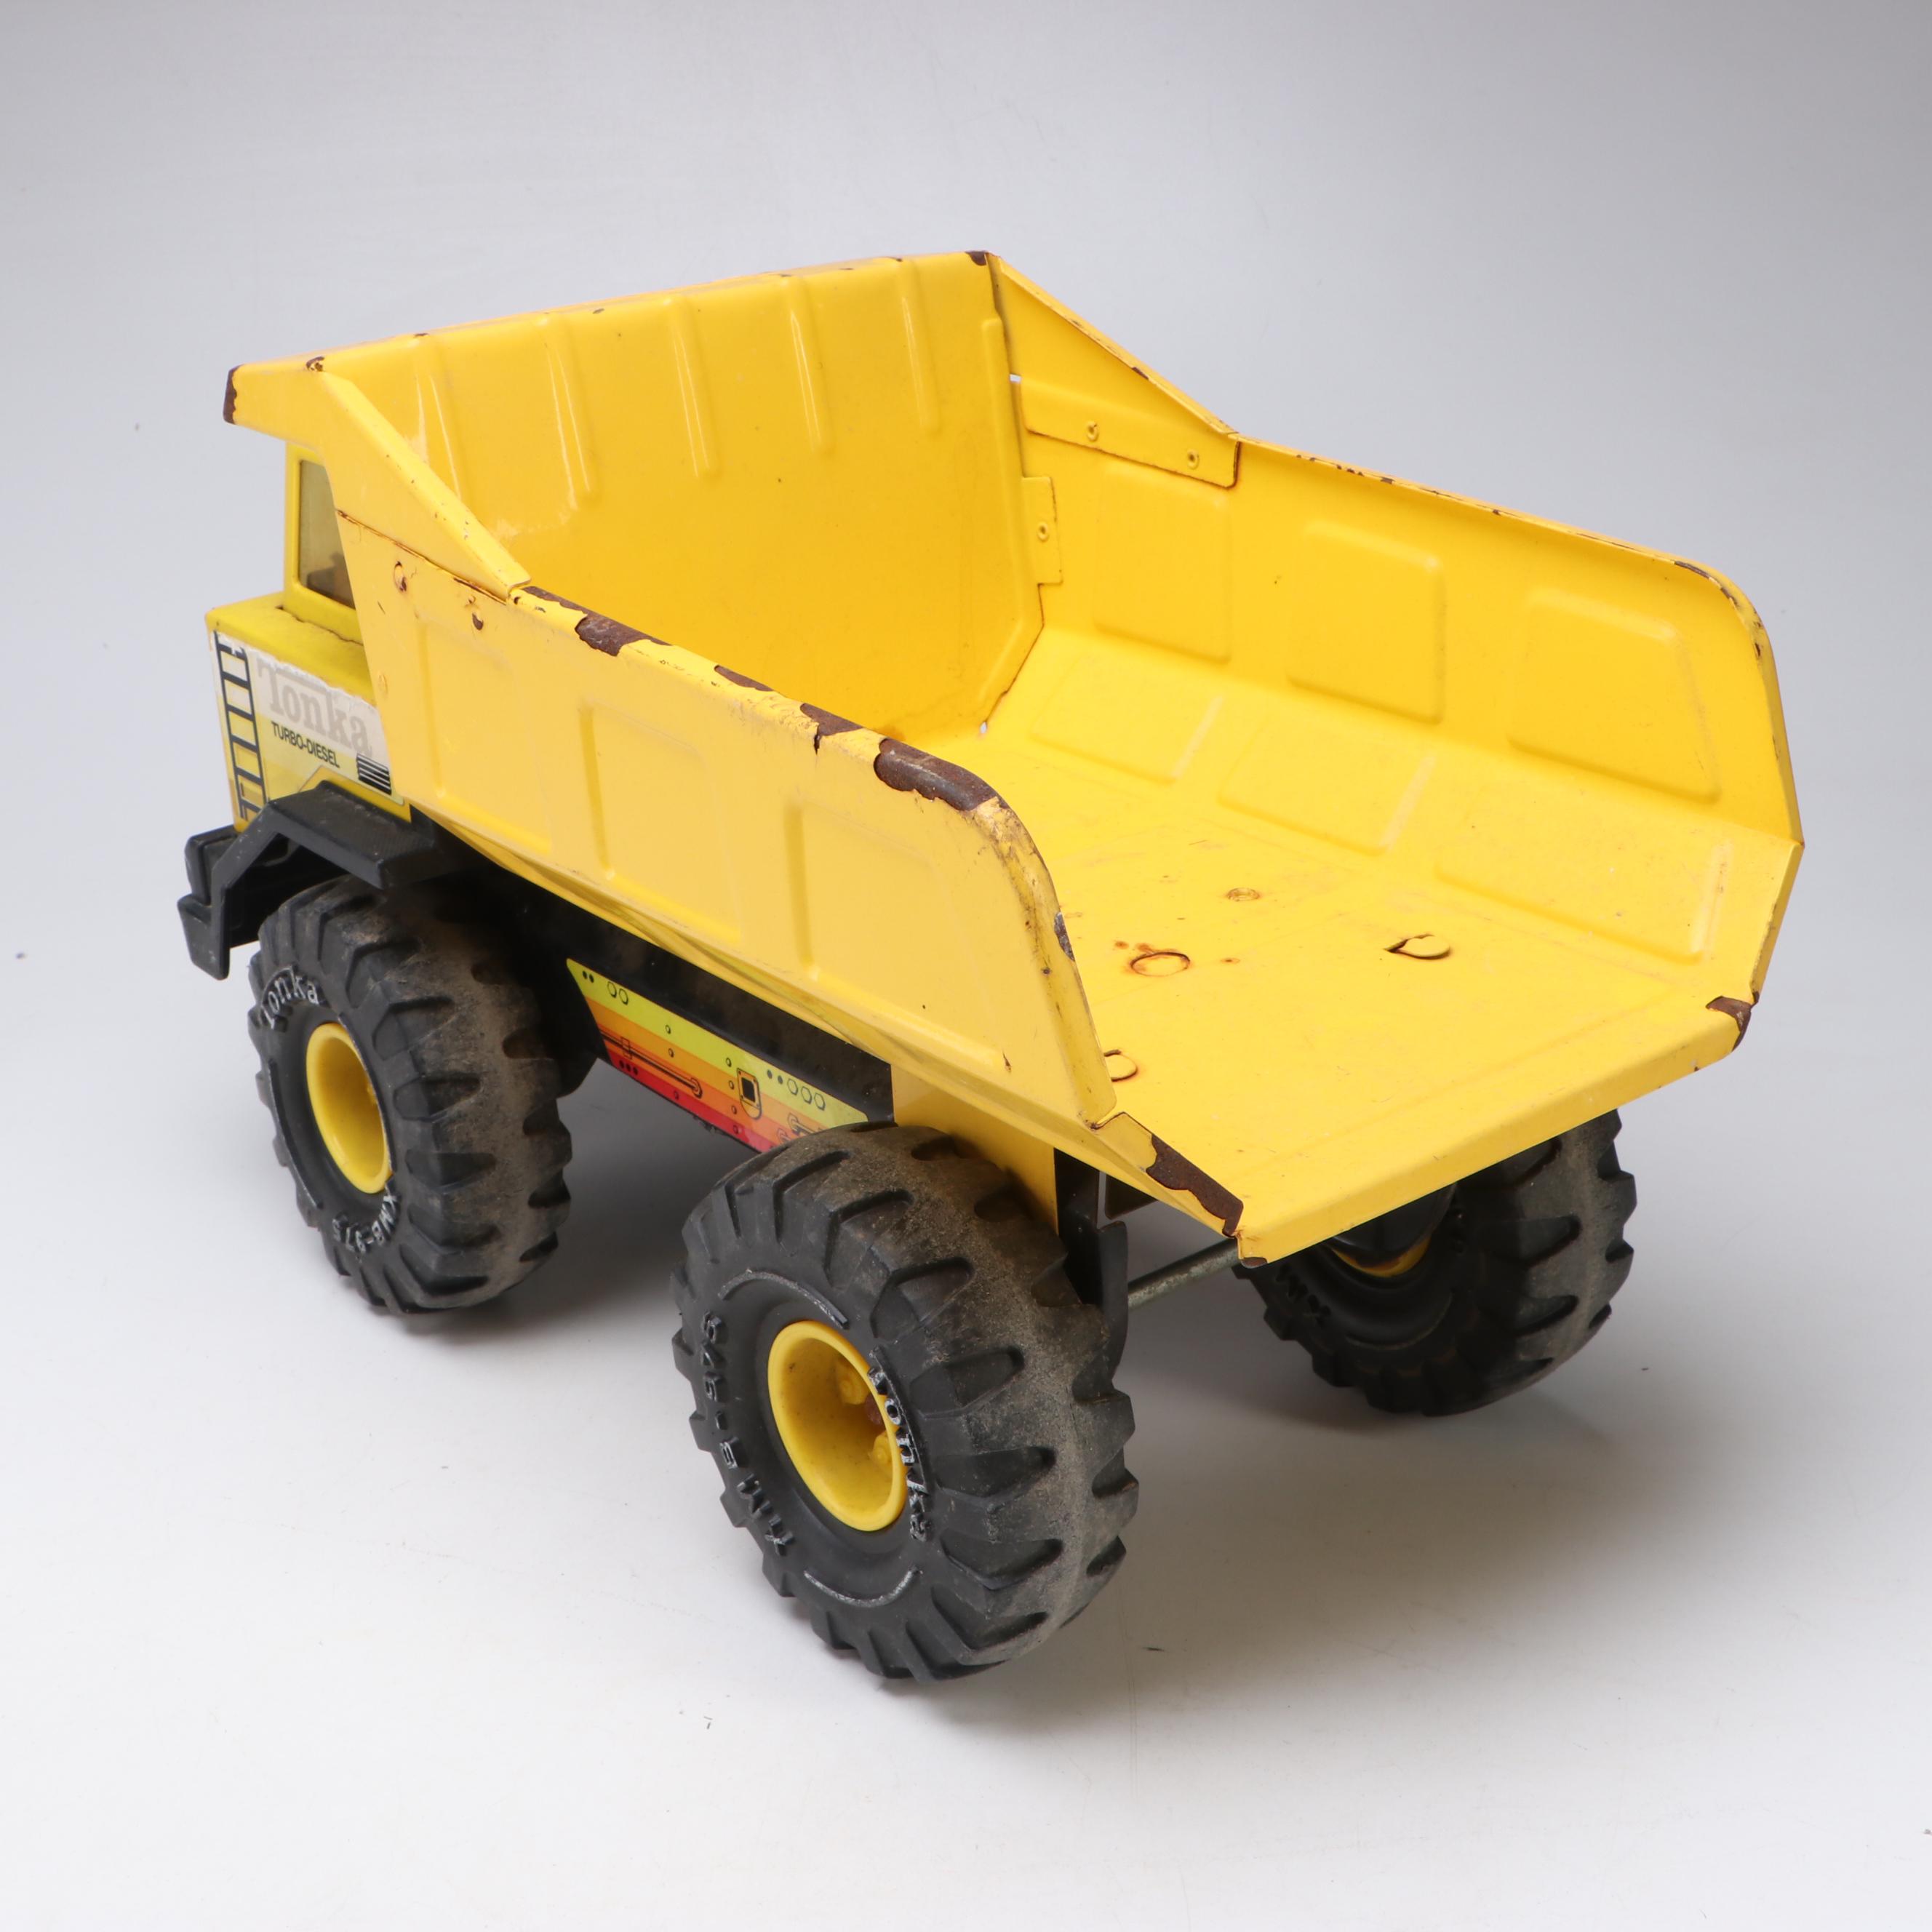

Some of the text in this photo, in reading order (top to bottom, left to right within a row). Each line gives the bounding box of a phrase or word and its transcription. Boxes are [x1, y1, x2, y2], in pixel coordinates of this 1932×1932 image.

[259, 661, 372, 757] Tonka
[271, 722, 340, 768] TURBO-DIESEL
[263, 966, 323, 1029] Tonka
